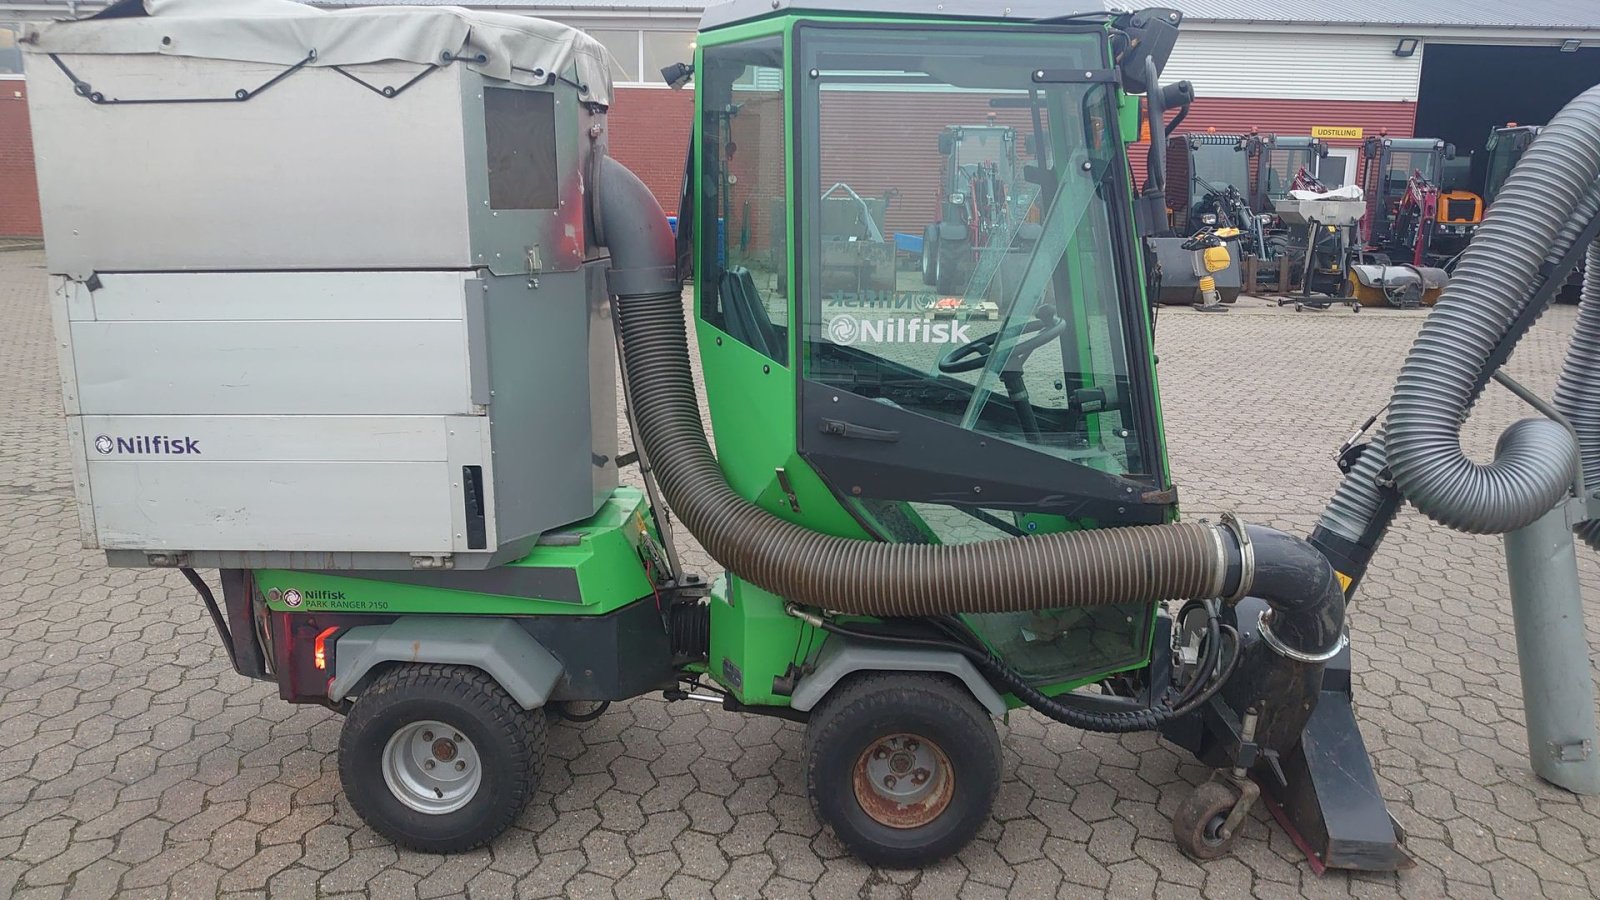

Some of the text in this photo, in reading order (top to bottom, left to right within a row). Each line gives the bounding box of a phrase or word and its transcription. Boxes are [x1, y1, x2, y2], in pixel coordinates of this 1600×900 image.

[1317, 129, 1357, 137] UDSTILLING
[860, 318, 971, 343] Nilfisk
[116, 435, 201, 454] Nilfisk
[305, 590, 346, 600] Nilfisk
[305, 600, 389, 609] PARK RANGER 2150
